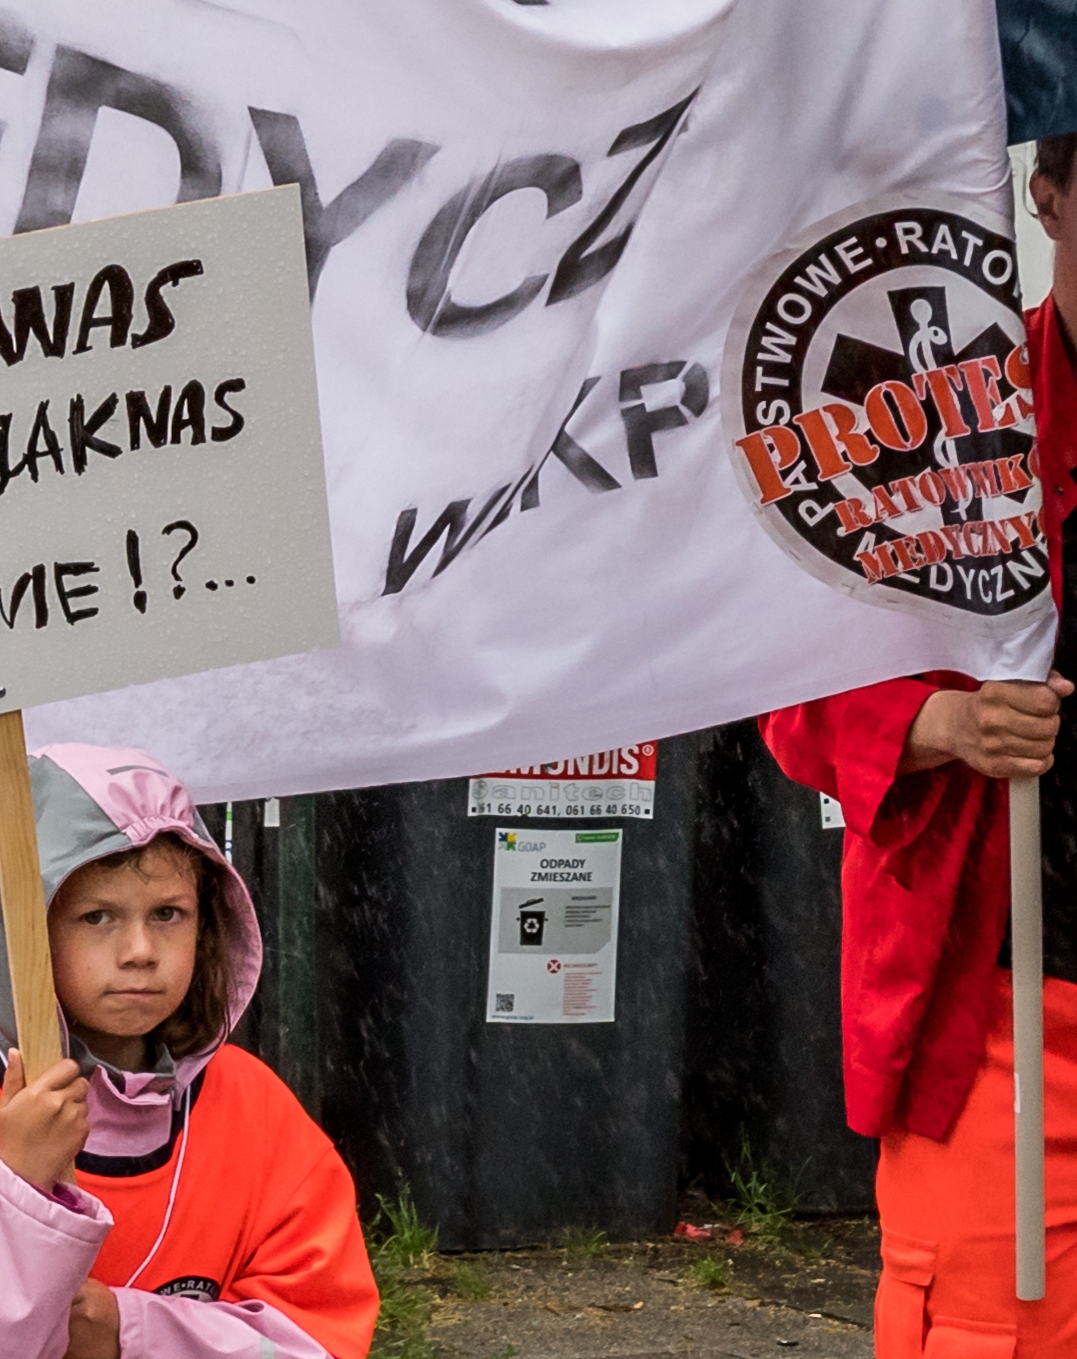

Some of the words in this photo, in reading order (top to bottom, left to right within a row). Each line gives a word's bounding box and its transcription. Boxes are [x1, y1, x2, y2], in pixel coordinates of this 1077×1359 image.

[754, 236, 874, 528] PASTWOWE
[894, 220, 1021, 299] RATO
[498, 803, 511, 814] 66
[517, 804, 532, 815] 40
[565, 805, 584, 815] 061
[590, 805, 602, 815] 66
[606, 804, 618, 814] 40
[621, 804, 641, 815] 650
[540, 859, 586, 869] ODPADY
[530, 872, 592, 882] ZMIESZANE
